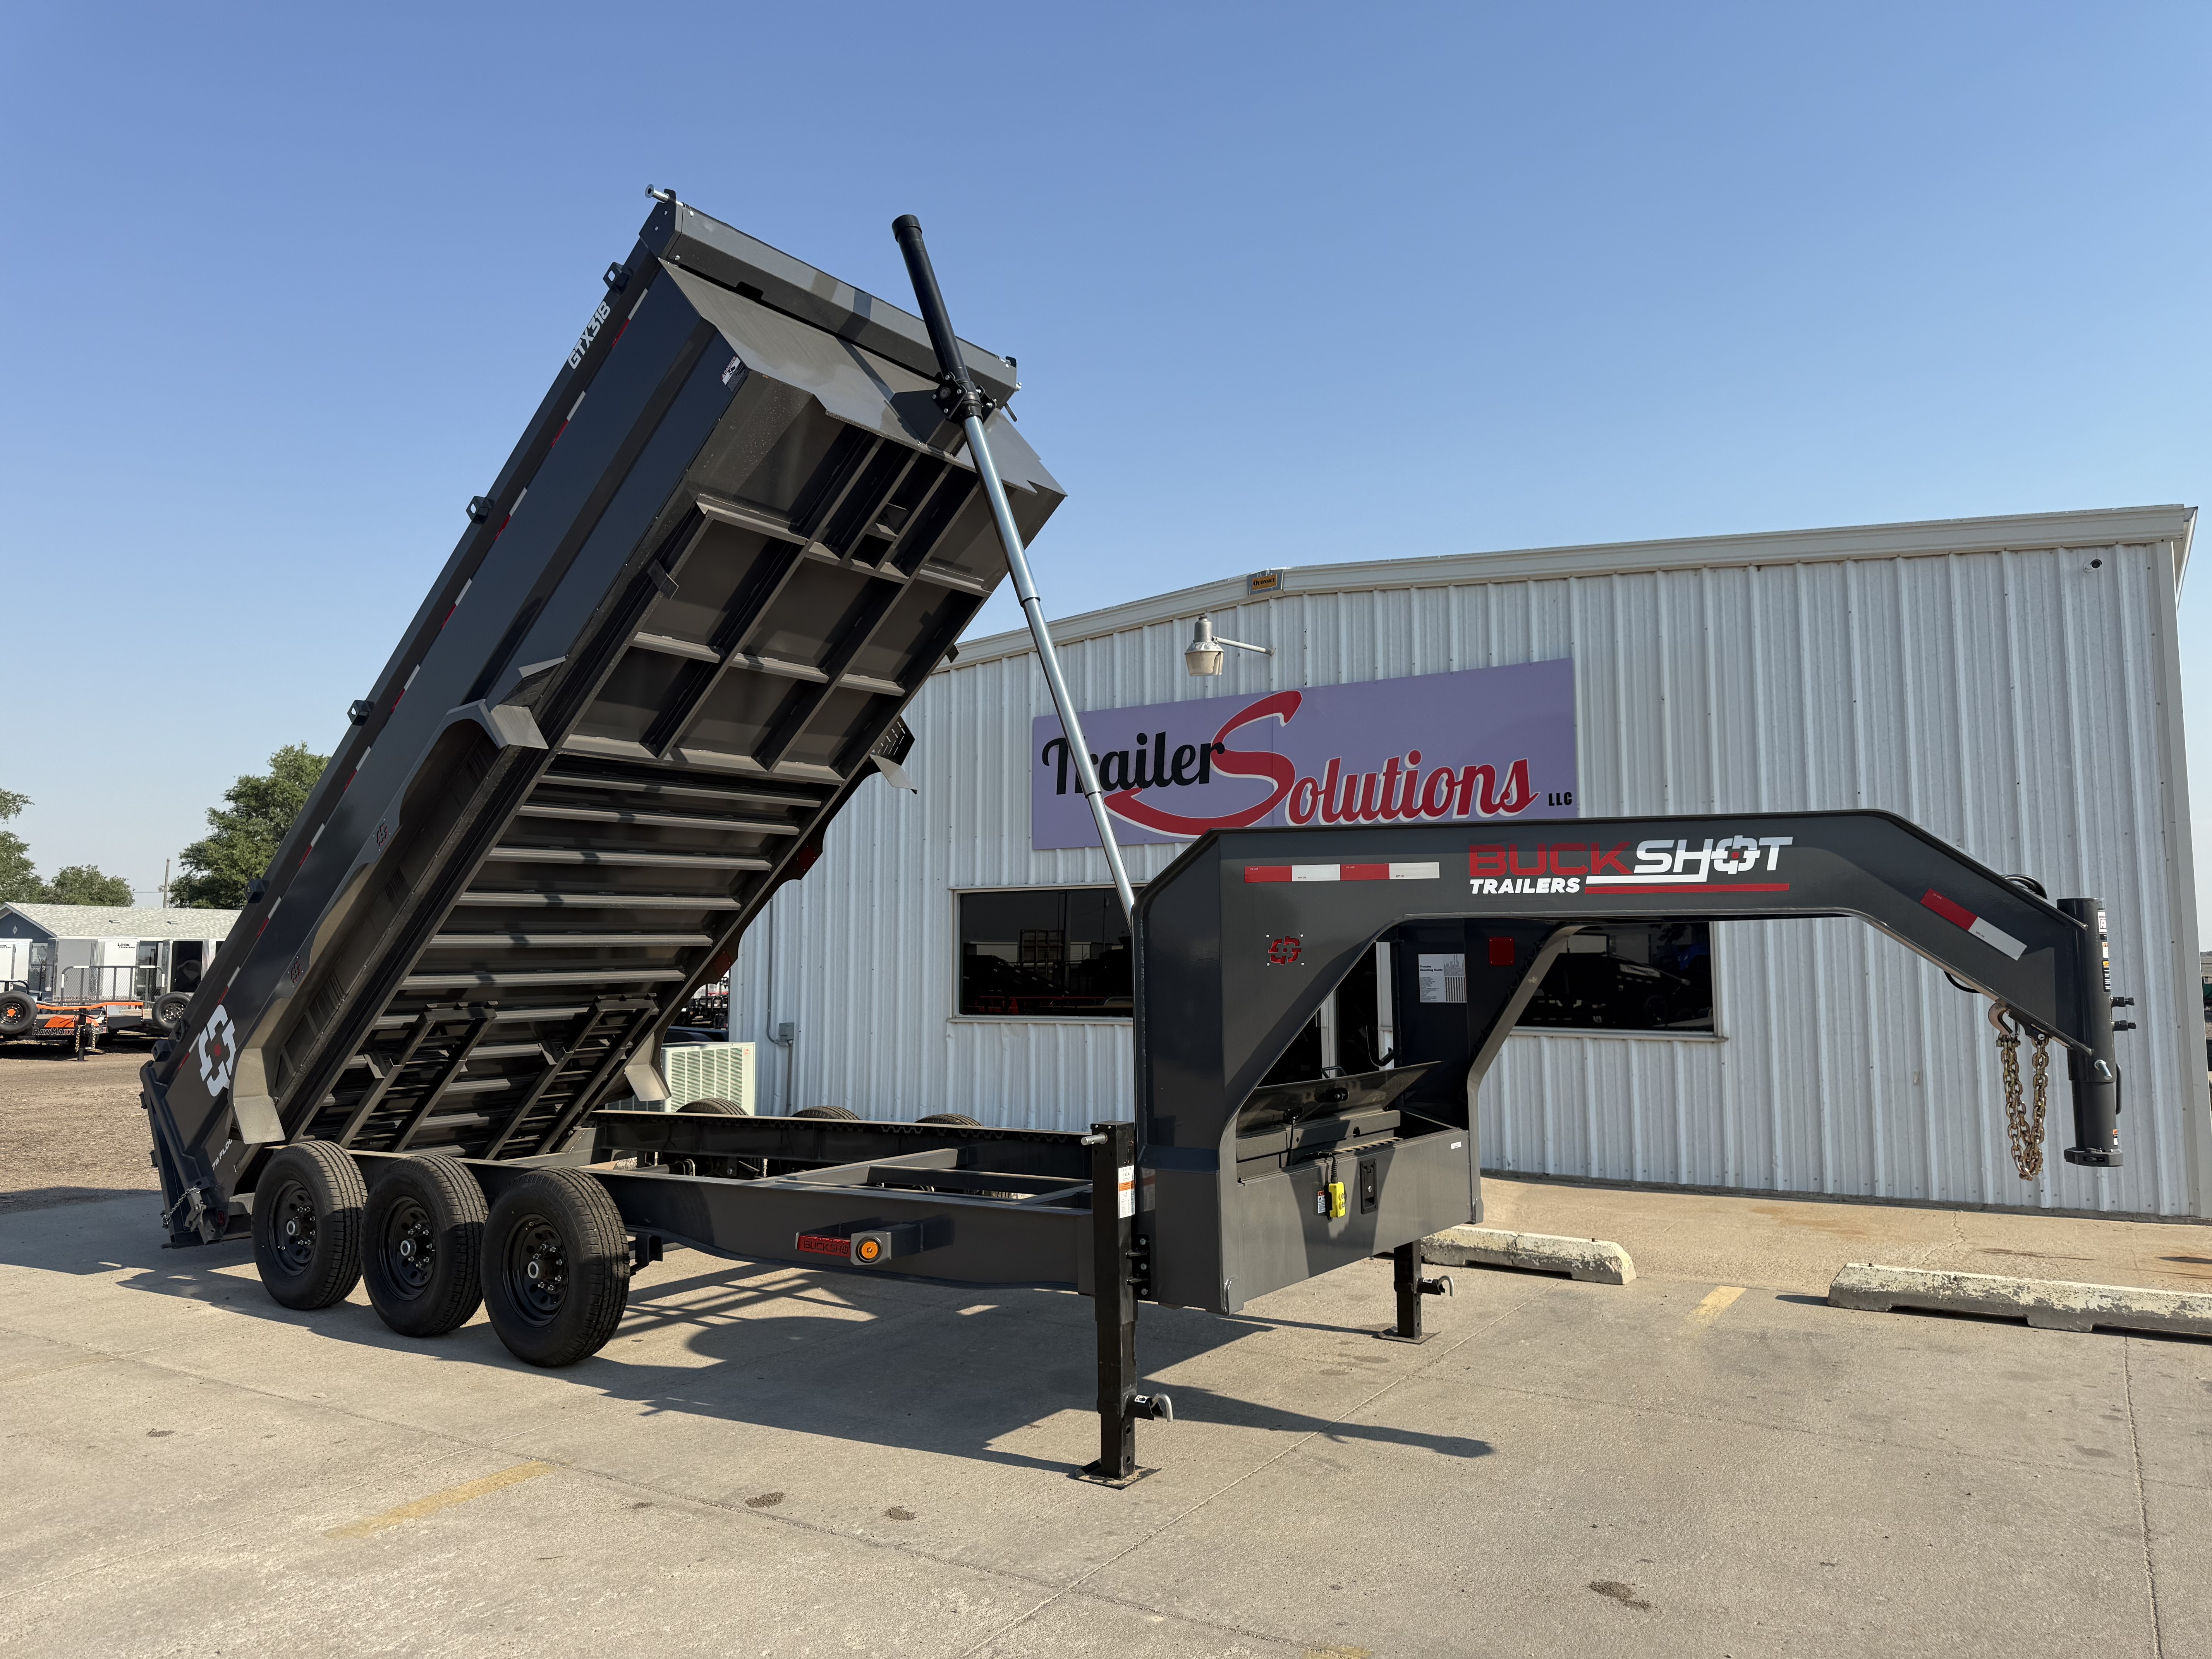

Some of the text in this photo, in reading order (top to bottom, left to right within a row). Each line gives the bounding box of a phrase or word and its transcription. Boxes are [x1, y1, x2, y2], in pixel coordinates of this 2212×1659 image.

[568, 301, 611, 369] GTX318
[724, 356, 736, 375] DANGER
[1103, 690, 1541, 838] Solutions
[1548, 792, 1572, 806] LLC
[1469, 835, 1793, 877] BUCKSHOT
[1470, 877, 1581, 894] TRAILERS
[804, 1240, 851, 1255] BUCKSHO
